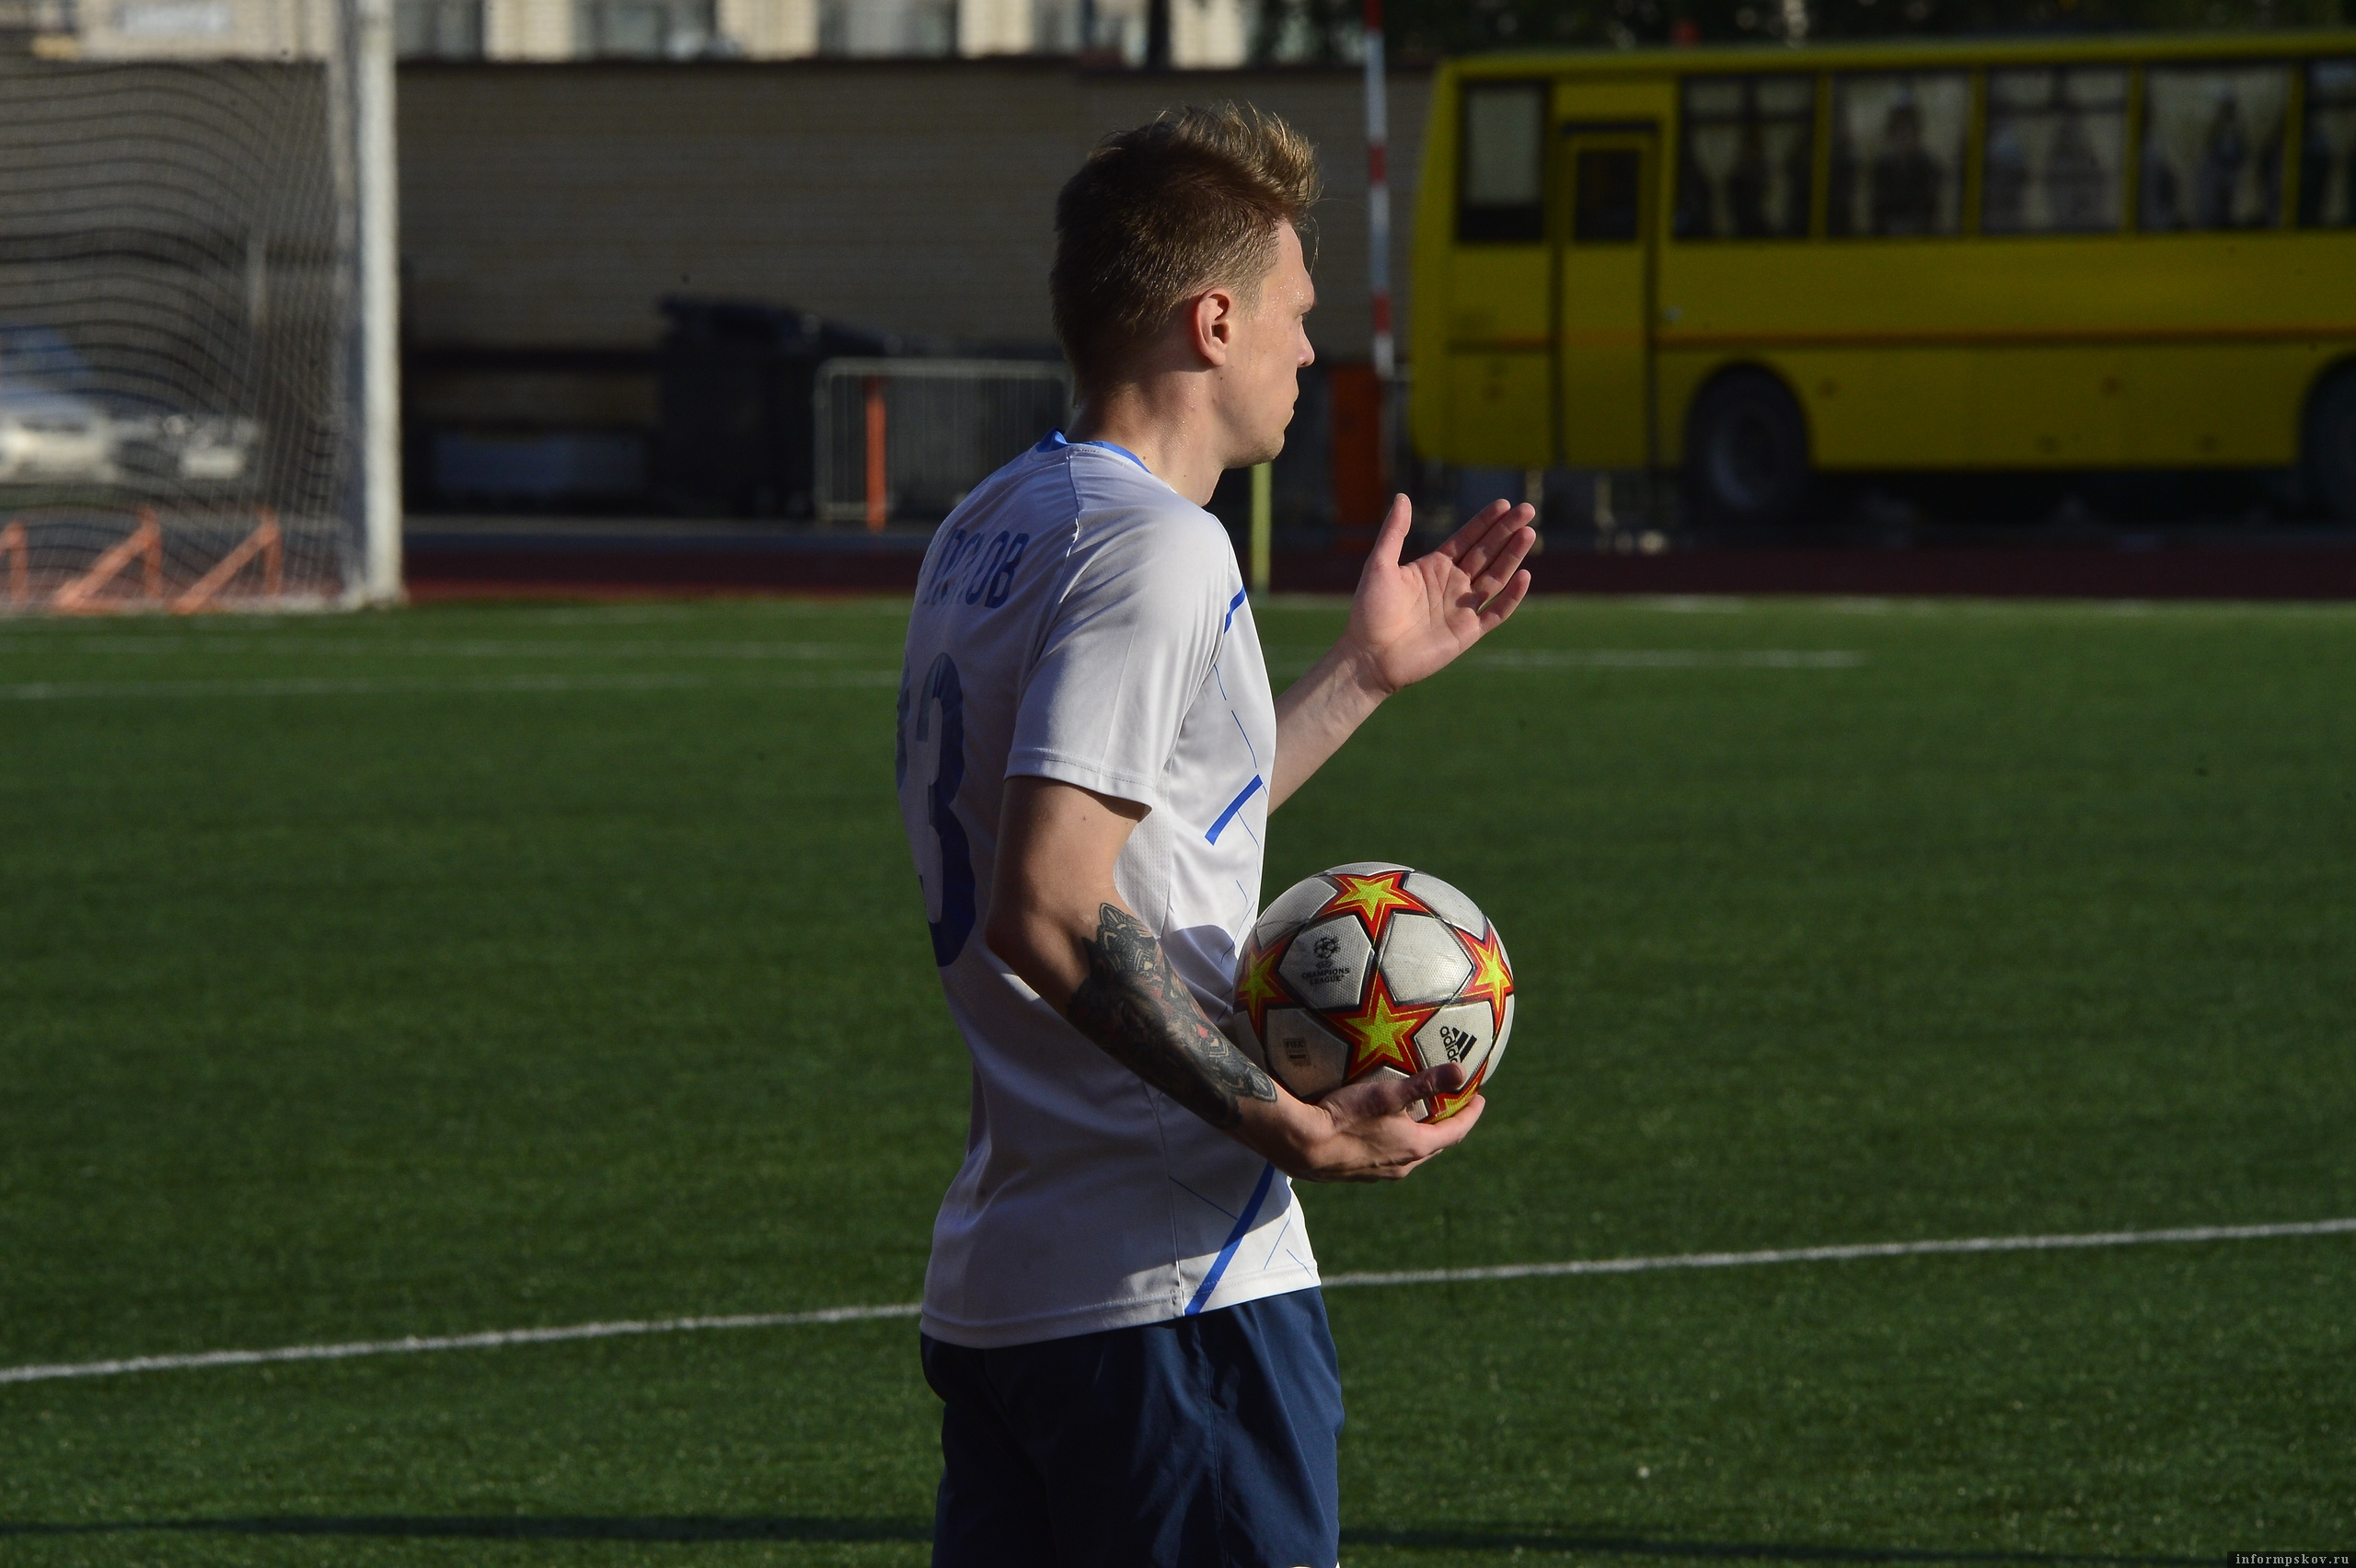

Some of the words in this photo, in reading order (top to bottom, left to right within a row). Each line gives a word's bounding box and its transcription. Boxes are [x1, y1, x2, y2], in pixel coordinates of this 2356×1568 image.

[895, 648, 976, 967] 3
[1301, 967, 1350, 979] CHAMPIONS
[1310, 974, 1342, 985] LEAGUE
[1440, 1026, 1460, 1063] adid
